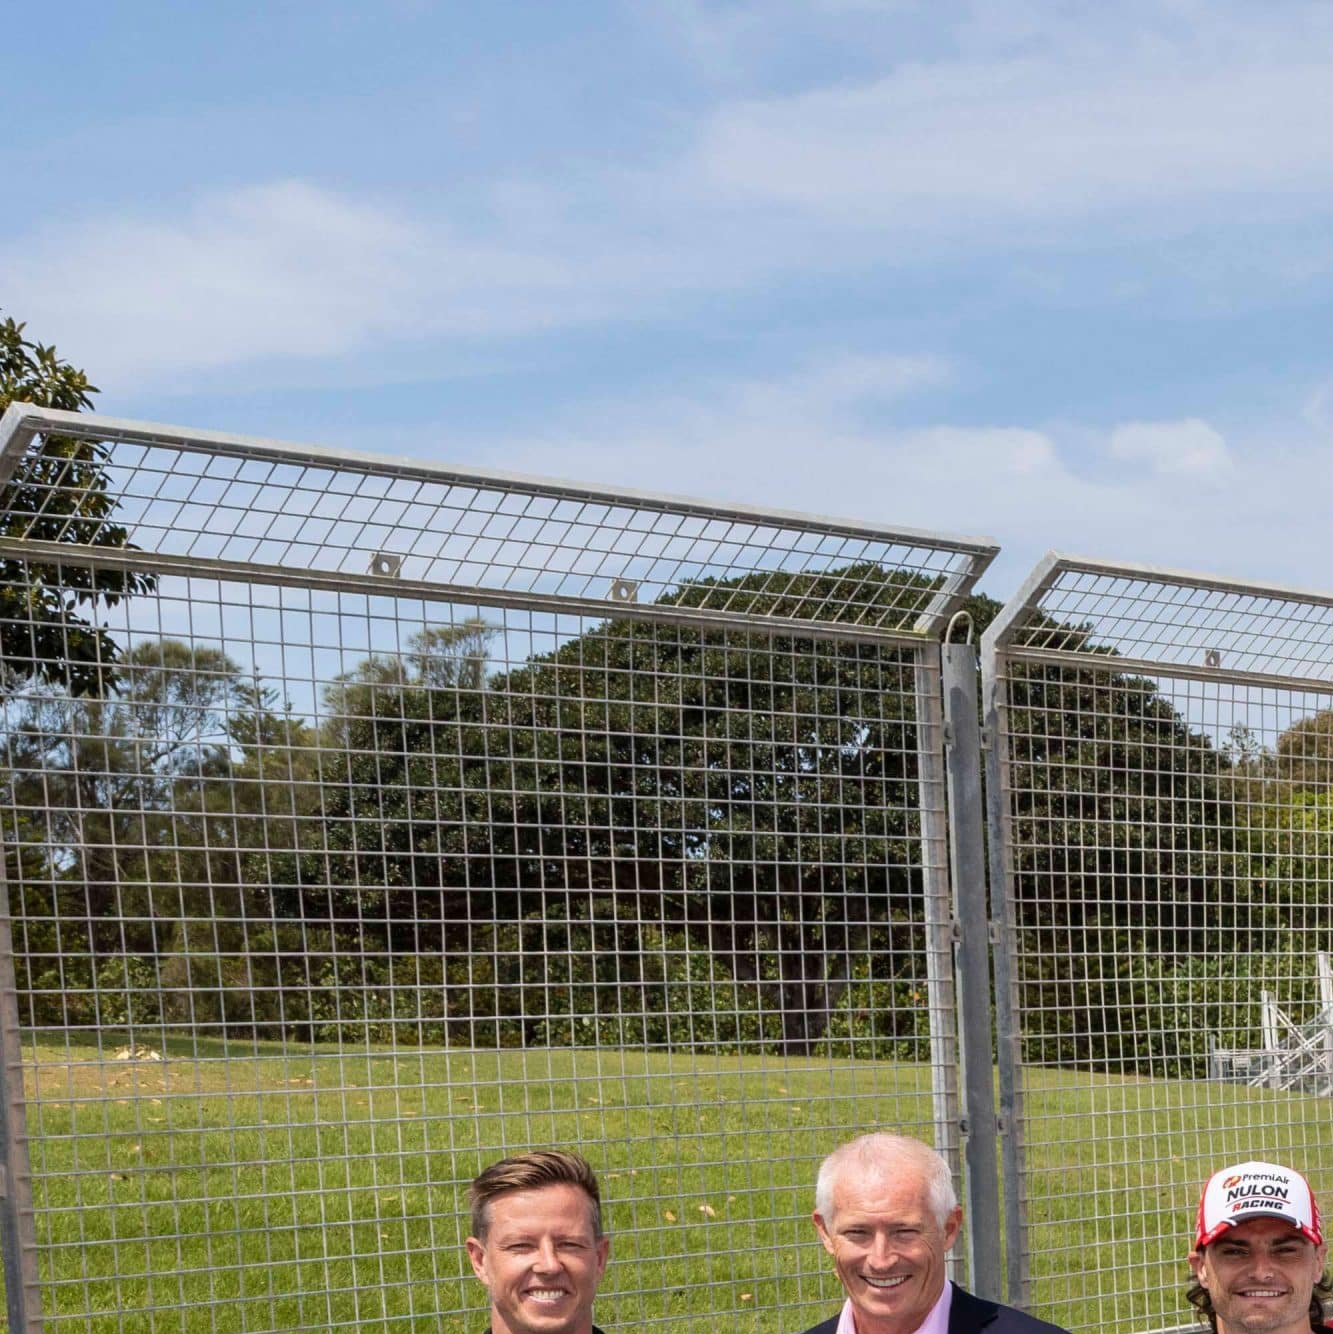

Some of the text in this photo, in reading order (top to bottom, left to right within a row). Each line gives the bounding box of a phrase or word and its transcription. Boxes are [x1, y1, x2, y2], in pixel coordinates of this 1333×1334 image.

[1242, 1173, 1290, 1185] PremiAir
[1226, 1184, 1289, 1202] NULON
[1231, 1199, 1284, 1213] RACING
